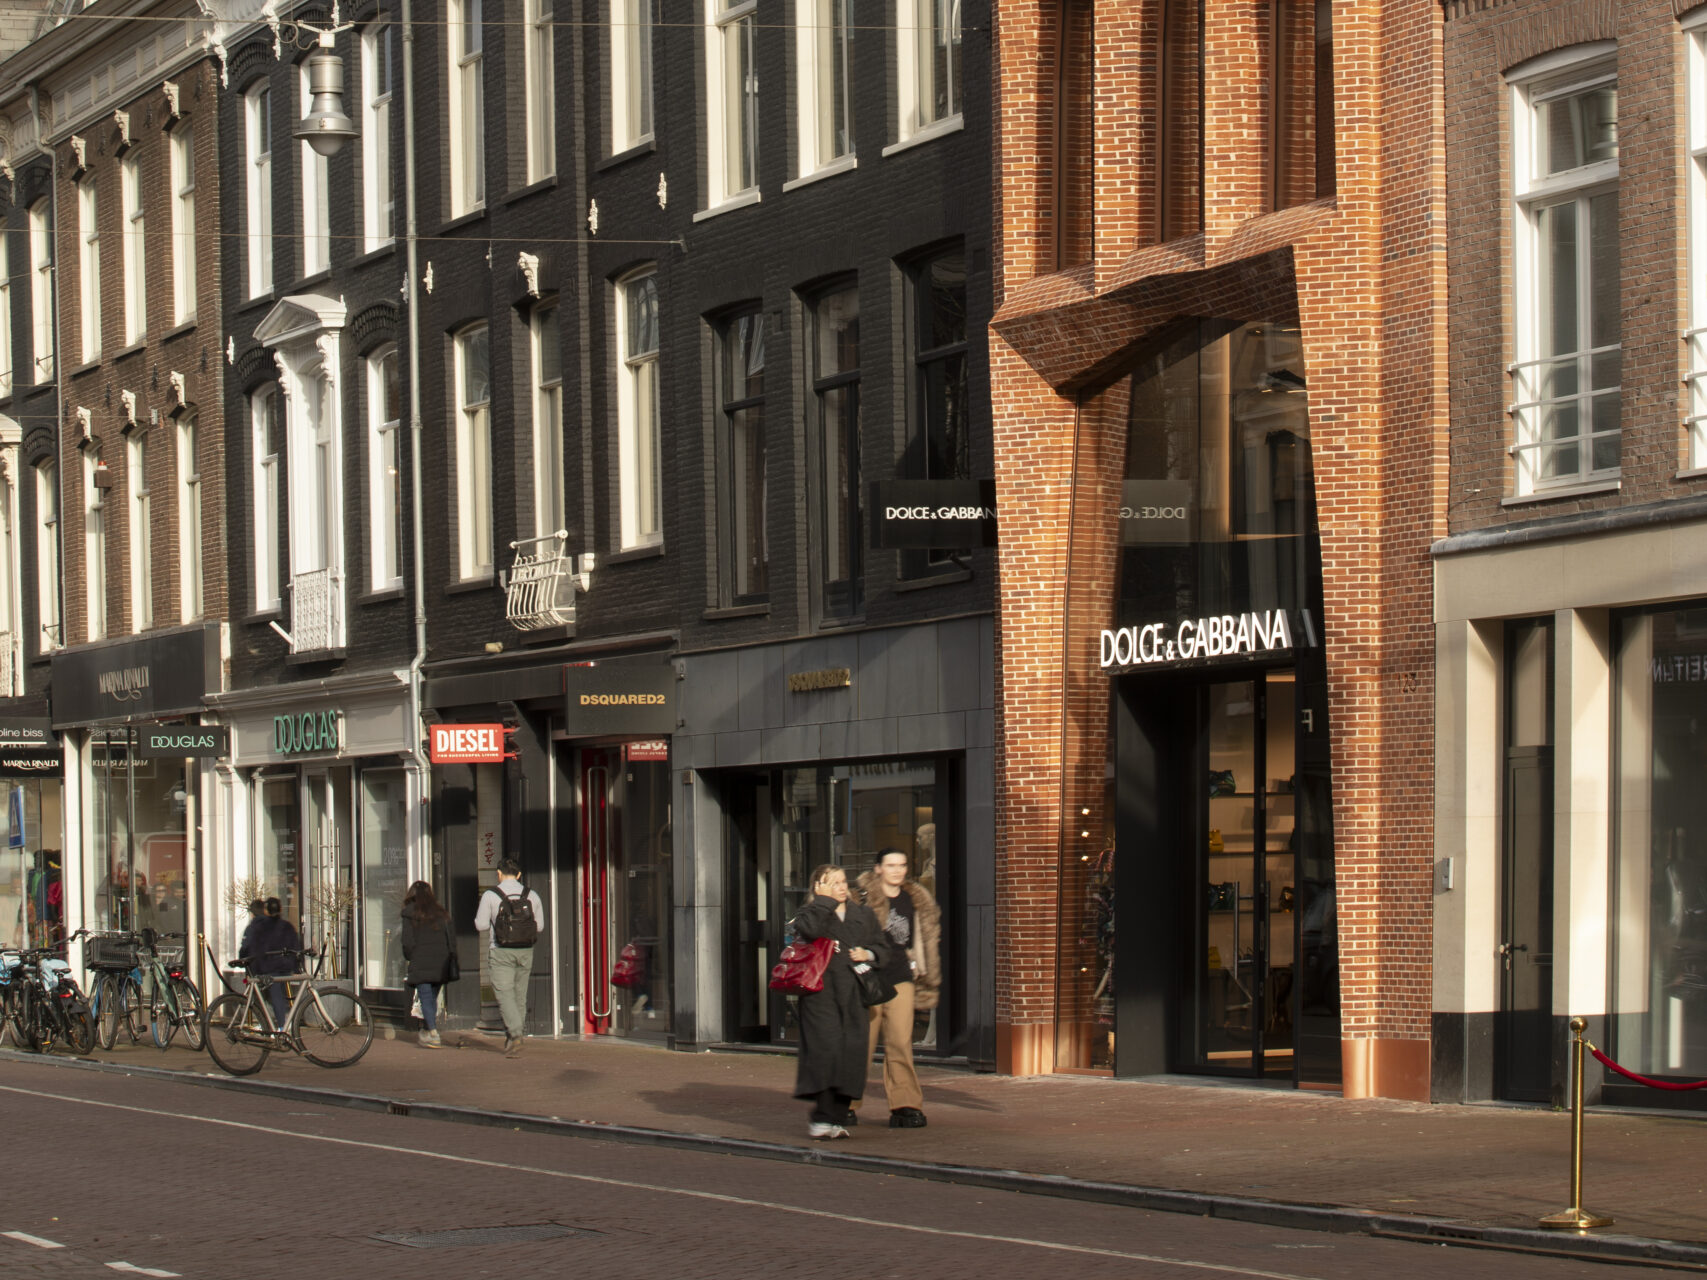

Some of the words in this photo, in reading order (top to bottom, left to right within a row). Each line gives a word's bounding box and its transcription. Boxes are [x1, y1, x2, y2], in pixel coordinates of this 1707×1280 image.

[886, 506, 930, 520] DOLCE
[1101, 622, 1164, 668] DOLCE
[1166, 639, 1175, 661] &
[1178, 609, 1290, 659] GABBANA
[580, 694, 666, 706] DSQUARED2
[22, 728, 44, 737] biss
[273, 709, 337, 753] DOUGLAS
[150, 735, 215, 748] DOUGLAS
[436, 729, 499, 753] DIESEL
[3, 760, 31, 769] MARINA
[32, 760, 59, 769] RINALDI
